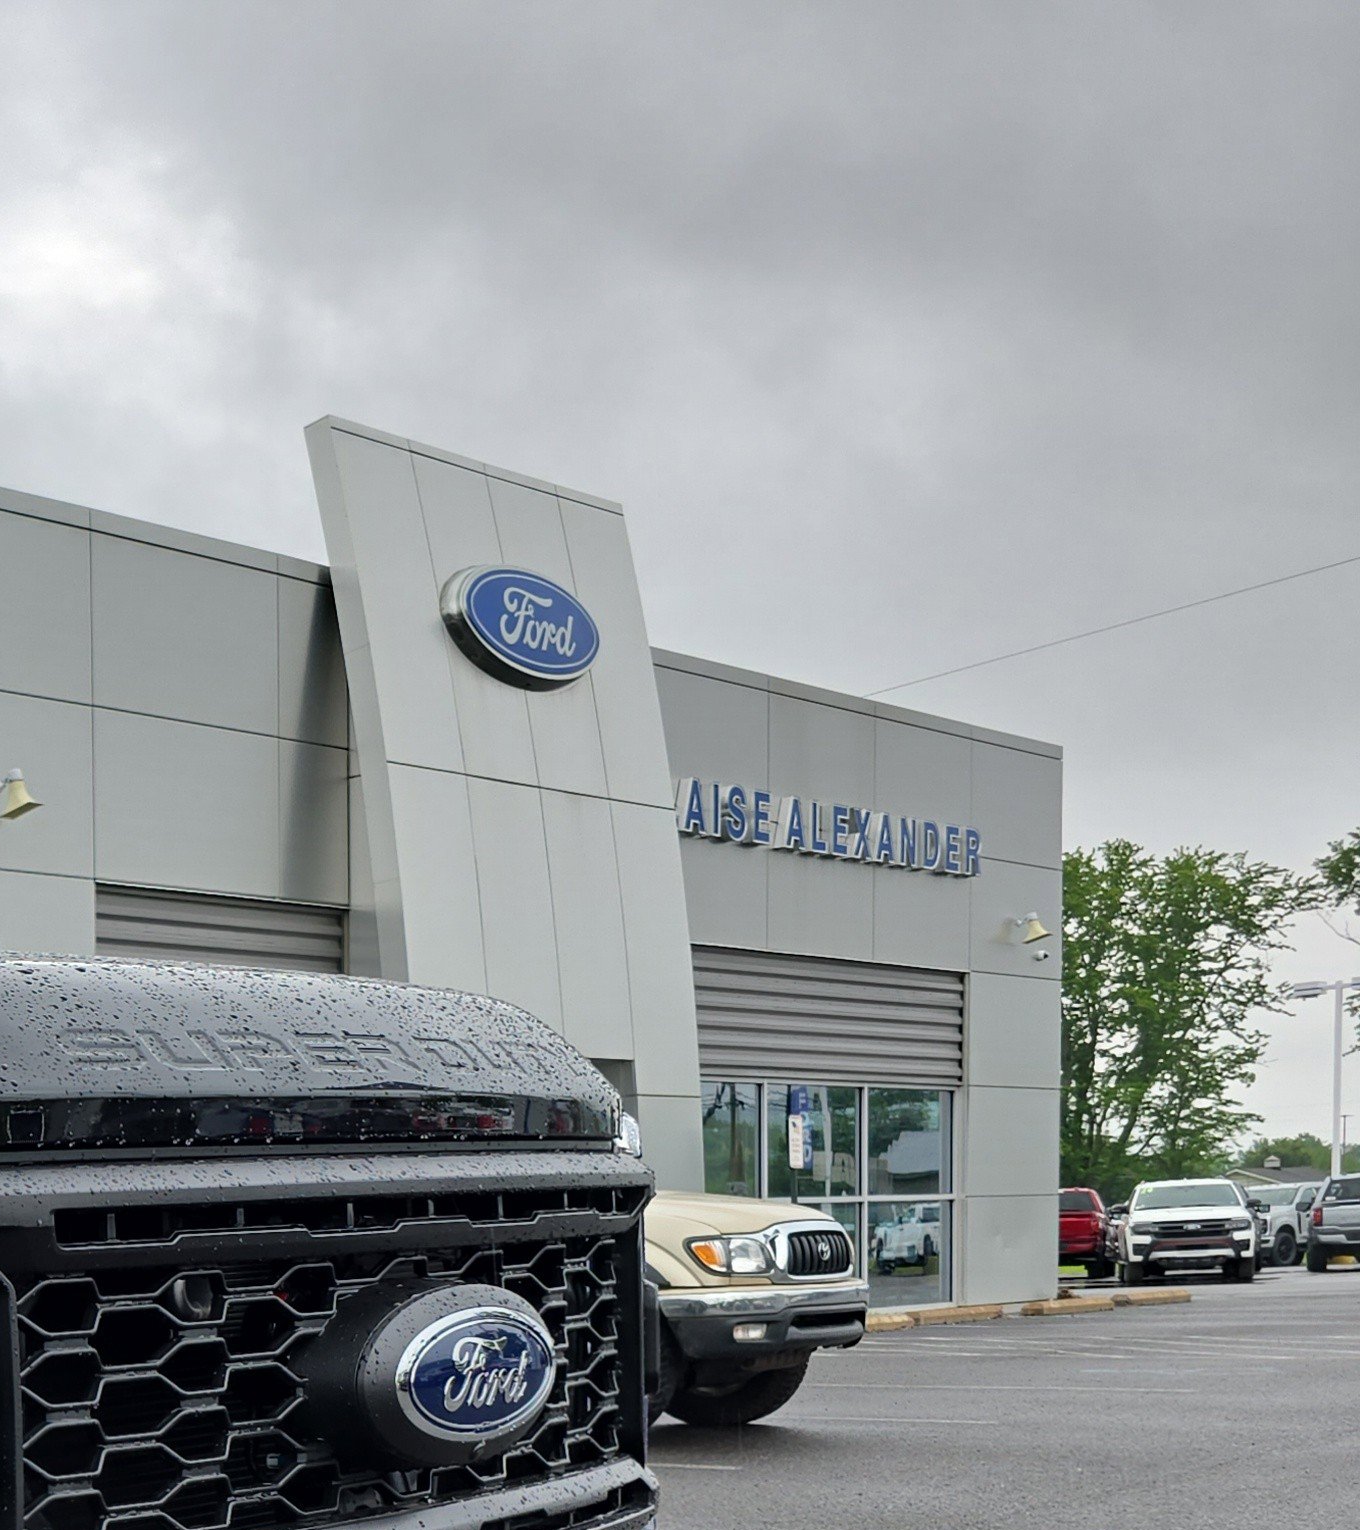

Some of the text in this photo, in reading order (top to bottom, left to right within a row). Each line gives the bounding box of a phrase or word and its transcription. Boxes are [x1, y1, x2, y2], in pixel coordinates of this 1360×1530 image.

[500, 587, 576, 657] Ford
[783, 795, 981, 877] ALEXANDER
[56, 1026, 422, 1072] SUPER
[444, 1336, 528, 1412] Ford
